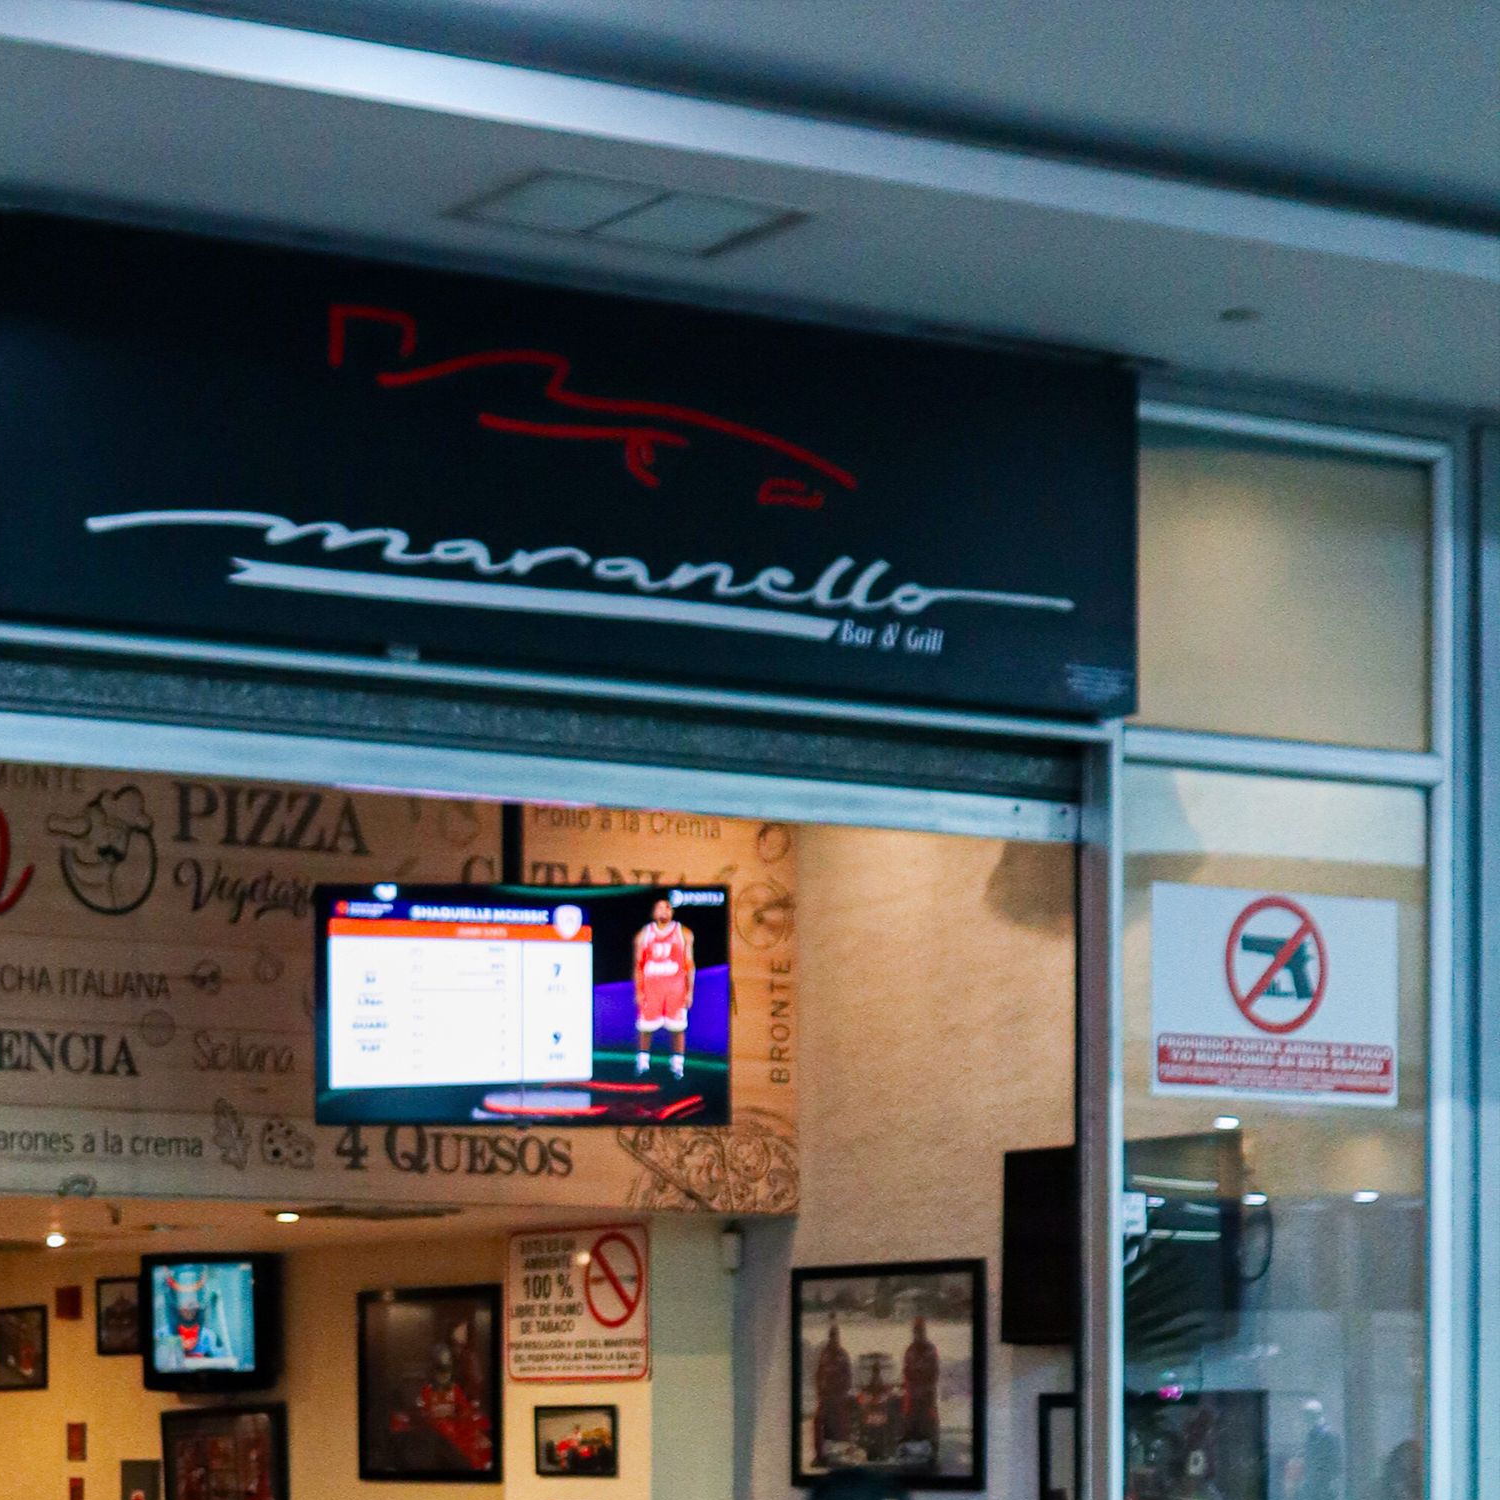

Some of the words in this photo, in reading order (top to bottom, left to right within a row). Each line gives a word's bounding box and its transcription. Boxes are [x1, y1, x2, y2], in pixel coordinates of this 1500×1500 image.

[86, 510, 1073, 616] maranello
[840, 618, 875, 647] Bar
[879, 620, 901, 649] &
[906, 626, 945, 656] Grill
[172, 780, 369, 856] PIZZA
[649, 813, 722, 840] Crema
[59, 966, 171, 999] ITALIANA
[769, 957, 792, 1086] BRONTE
[82, 1130, 95, 1154] a
[103, 1128, 127, 1156] la
[134, 1134, 203, 1159] crema
[334, 1125, 369, 1171] 4
[384, 1126, 574, 1177] QUESOS
[523, 1273, 553, 1299] 100
[557, 1272, 574, 1299] %
